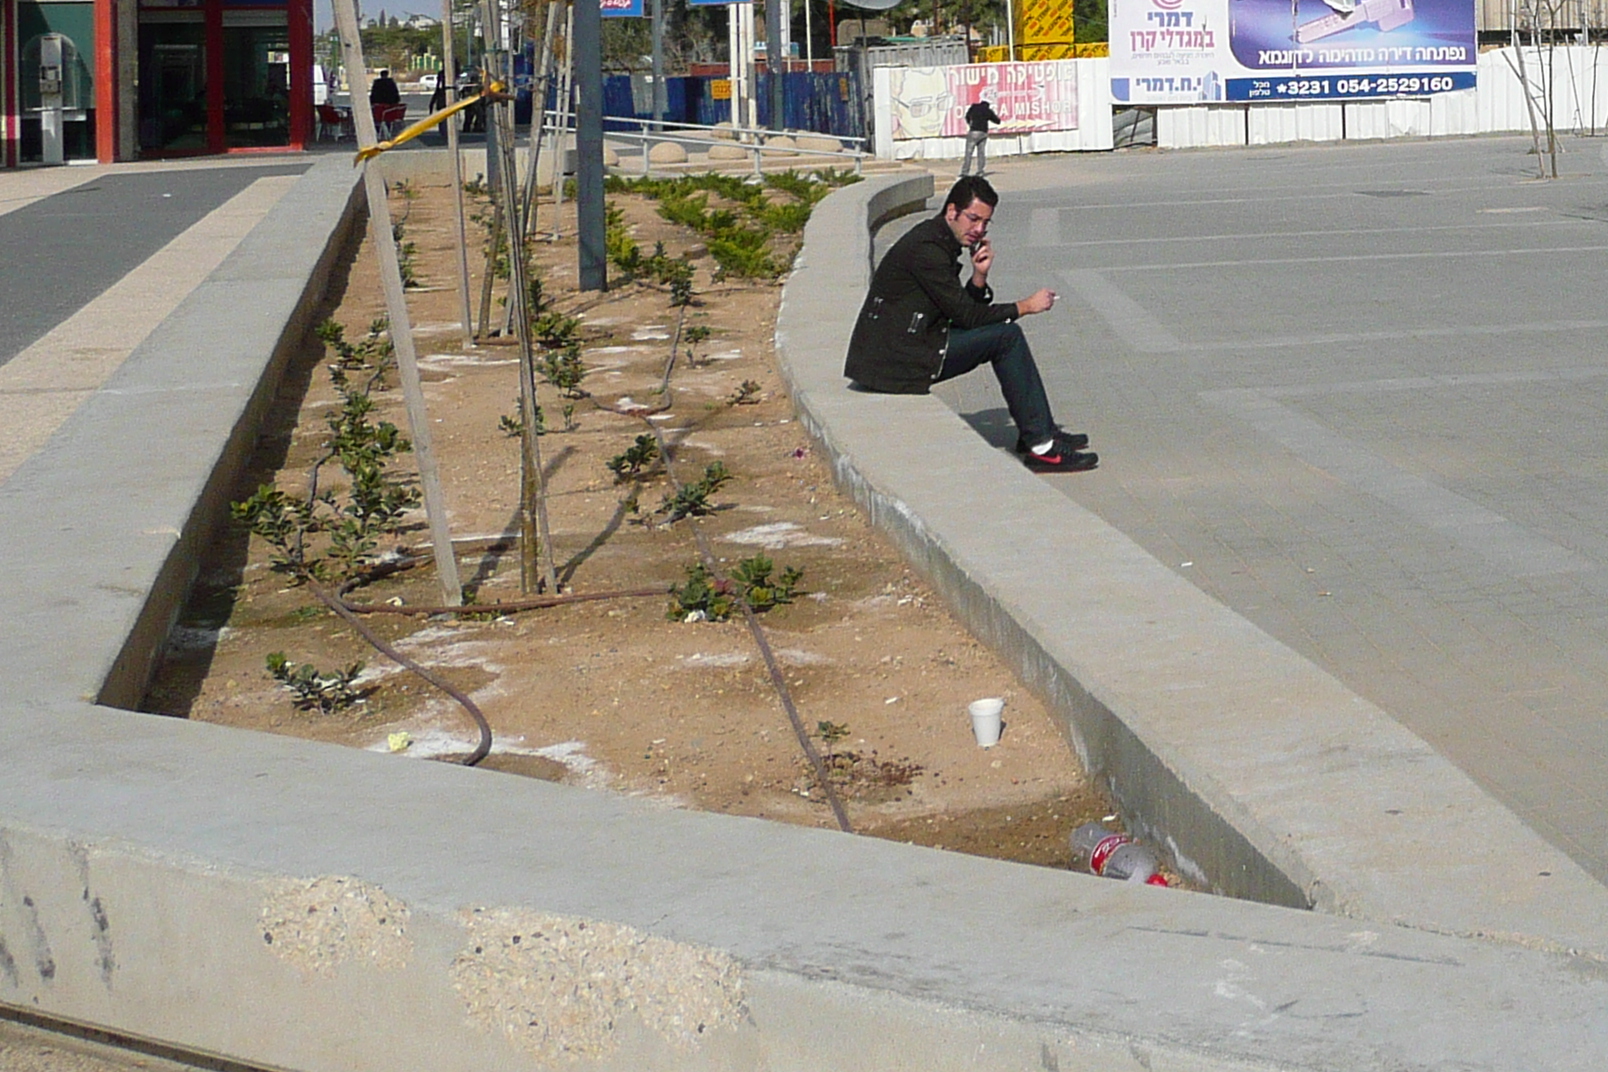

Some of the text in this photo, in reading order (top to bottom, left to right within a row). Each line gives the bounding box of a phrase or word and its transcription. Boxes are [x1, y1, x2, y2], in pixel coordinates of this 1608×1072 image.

[1147, 12, 1194, 28] דמרי
[1130, 30, 1158, 51] קרן
[1160, 29, 1215, 49] במגדלי
[1378, 46, 1412, 62] דירה
[1415, 46, 1466, 61] נפתחה
[950, 66, 999, 86] מישור
[1136, 78, 1202, 93] י.ח.דמרי
[1337, 77, 1453, 94] 054-2529160
[1014, 101, 1073, 115] MISHOR
